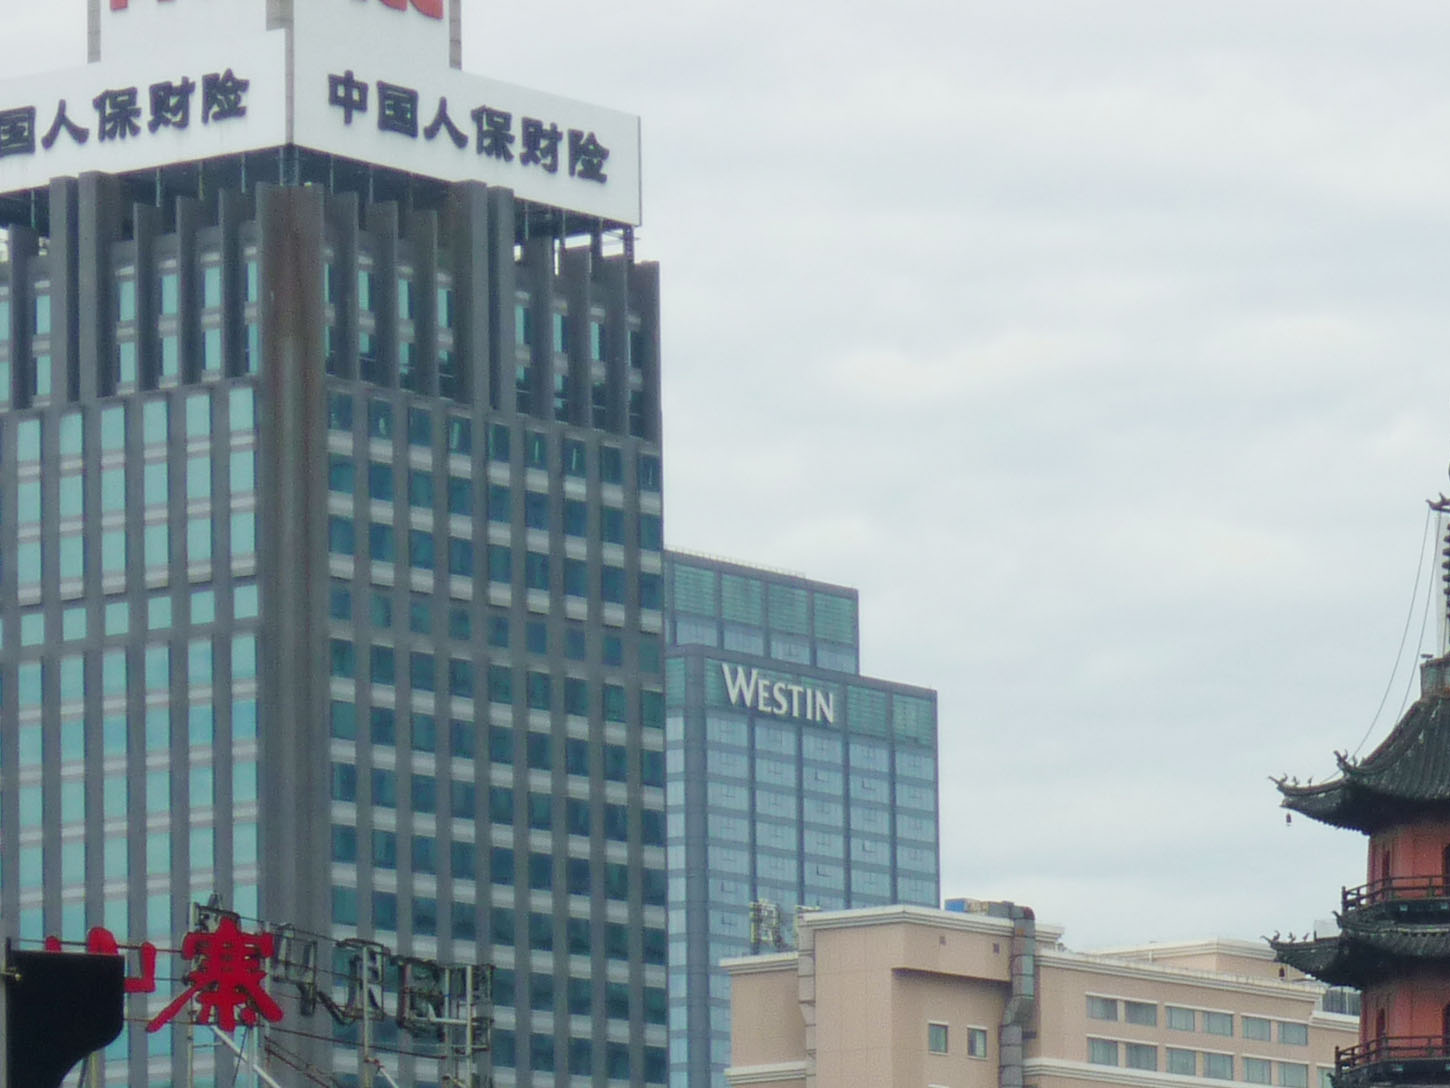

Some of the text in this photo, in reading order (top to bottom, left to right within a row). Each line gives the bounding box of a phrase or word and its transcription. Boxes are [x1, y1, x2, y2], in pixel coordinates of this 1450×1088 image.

[327, 69, 610, 183] 中国人保财险
[721, 661, 834, 725] WESTIN
